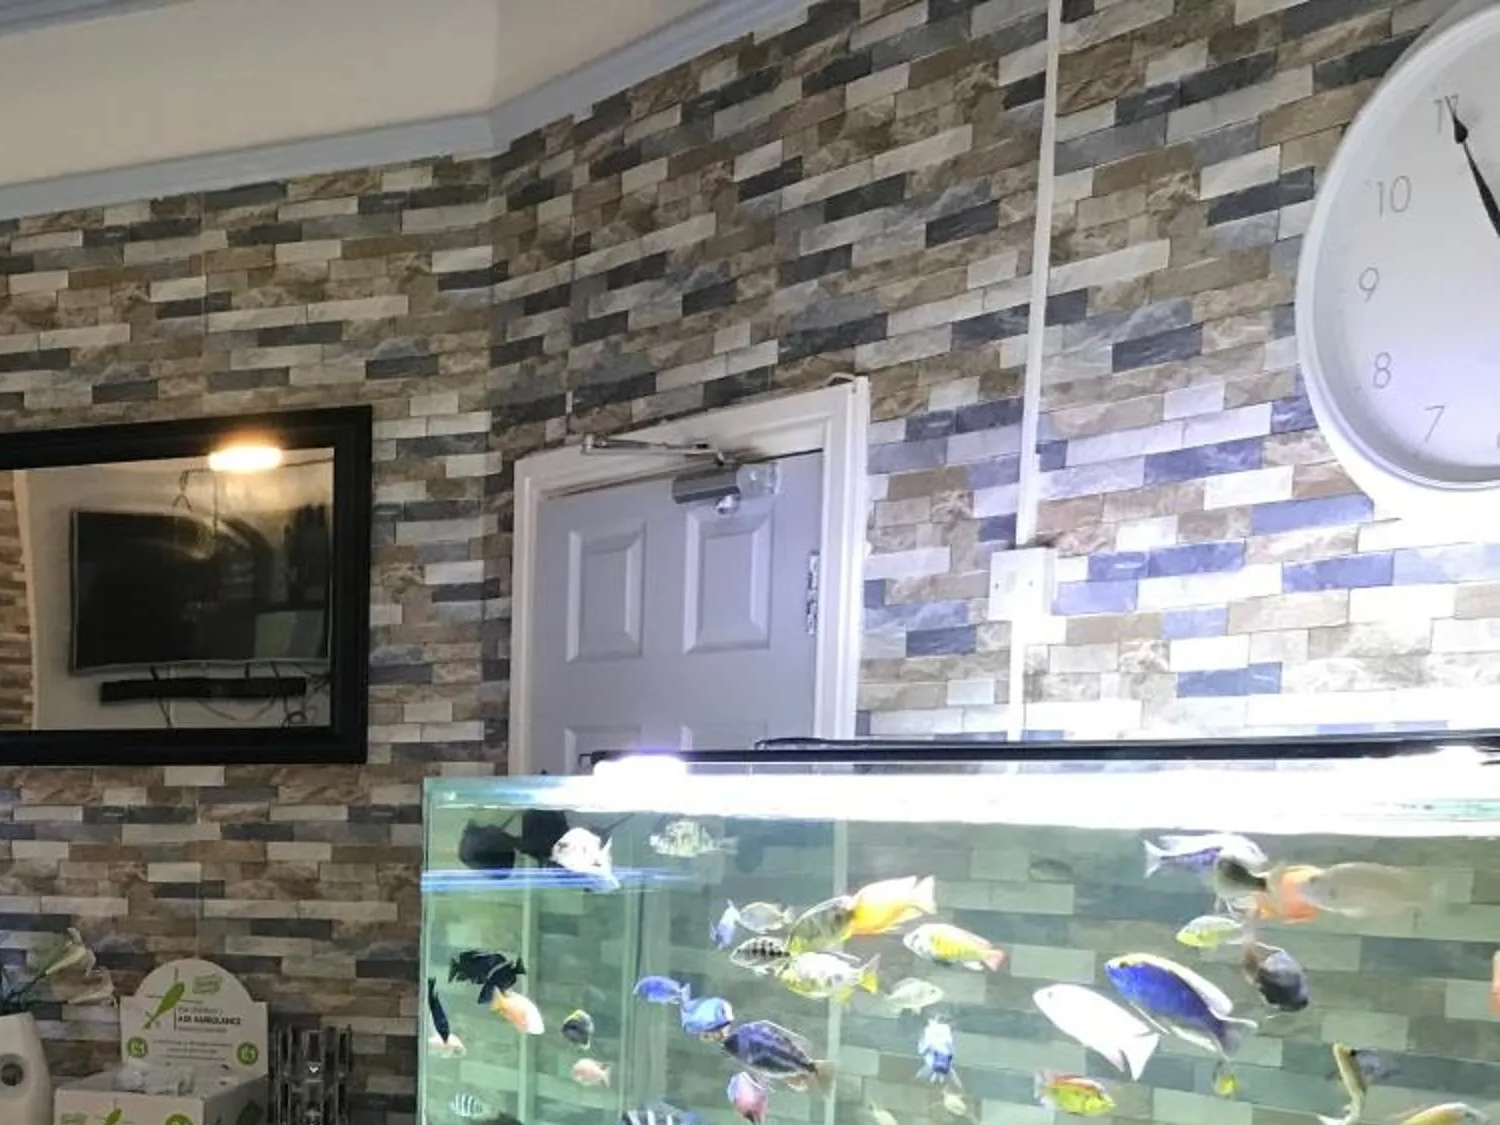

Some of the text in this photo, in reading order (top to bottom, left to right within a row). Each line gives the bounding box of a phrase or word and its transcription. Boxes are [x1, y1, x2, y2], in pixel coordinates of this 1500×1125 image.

[1376, 175, 1412, 218] 10
[1359, 266, 1380, 301] 9
[1373, 351, 1392, 389] 8
[1424, 405, 1445, 442] 7
